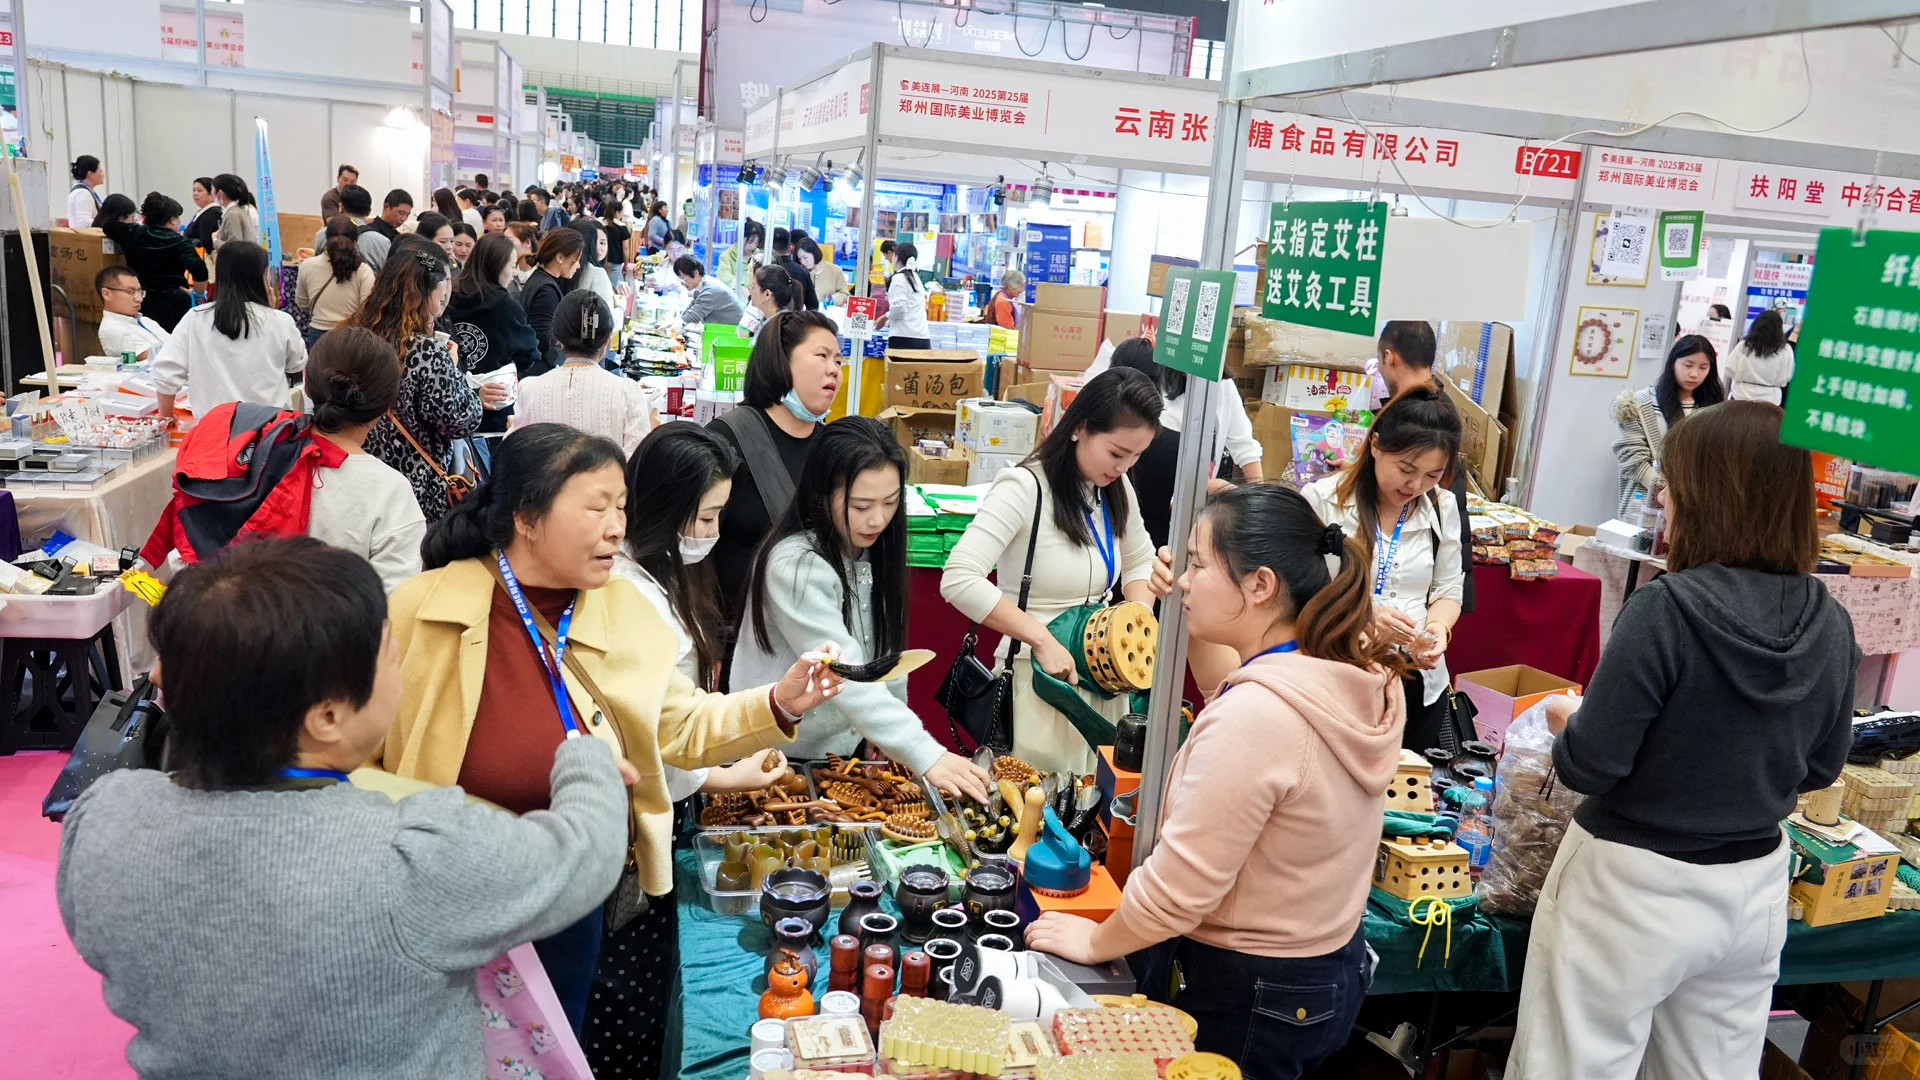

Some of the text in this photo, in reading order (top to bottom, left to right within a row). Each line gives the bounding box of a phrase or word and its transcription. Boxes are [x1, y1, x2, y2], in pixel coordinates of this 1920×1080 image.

[972, 88, 1030, 104] 2025第25届
[899, 98, 1027, 125] 郑州国际美业博览会
[1115, 107, 1460, 168] 云南张糖食品有限公司
[1521, 151, 1572, 174] B721
[1658, 159, 1704, 174] 2025第25届
[1598, 169, 1700, 192] 郑州国际美业博览会
[1750, 174, 1826, 204] 扶阳堂
[1271, 217, 1380, 262] 买指定艾柱
[1266, 267, 1373, 319] 送艾灸工具
[722, 359, 748, 375] 云南
[903, 371, 969, 397] 菌汤包
